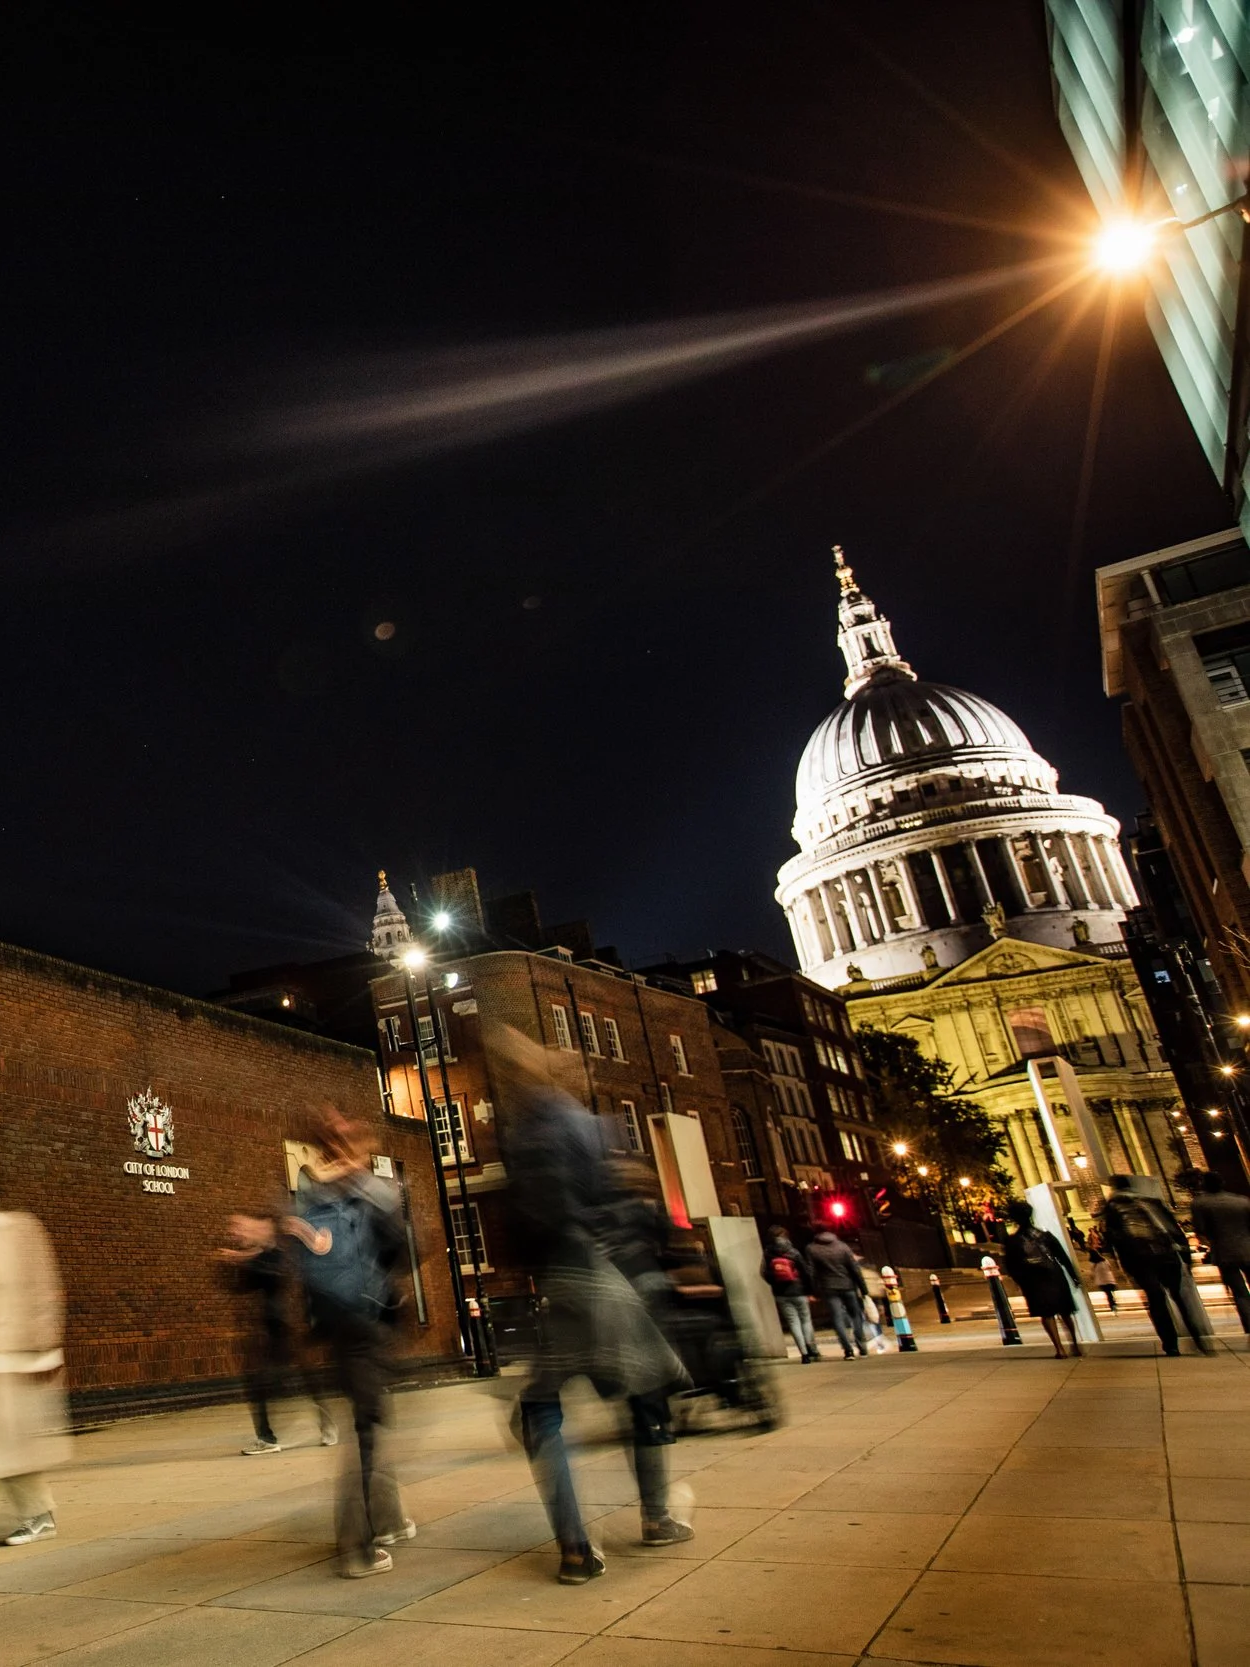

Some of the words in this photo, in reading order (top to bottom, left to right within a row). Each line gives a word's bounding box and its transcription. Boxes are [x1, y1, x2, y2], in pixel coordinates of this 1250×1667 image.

[123, 1161, 143, 1175] CITY
[142, 1163, 156, 1176] OF
[155, 1164, 190, 1179] LONDON
[142, 1180, 175, 1194] SCHOOL
